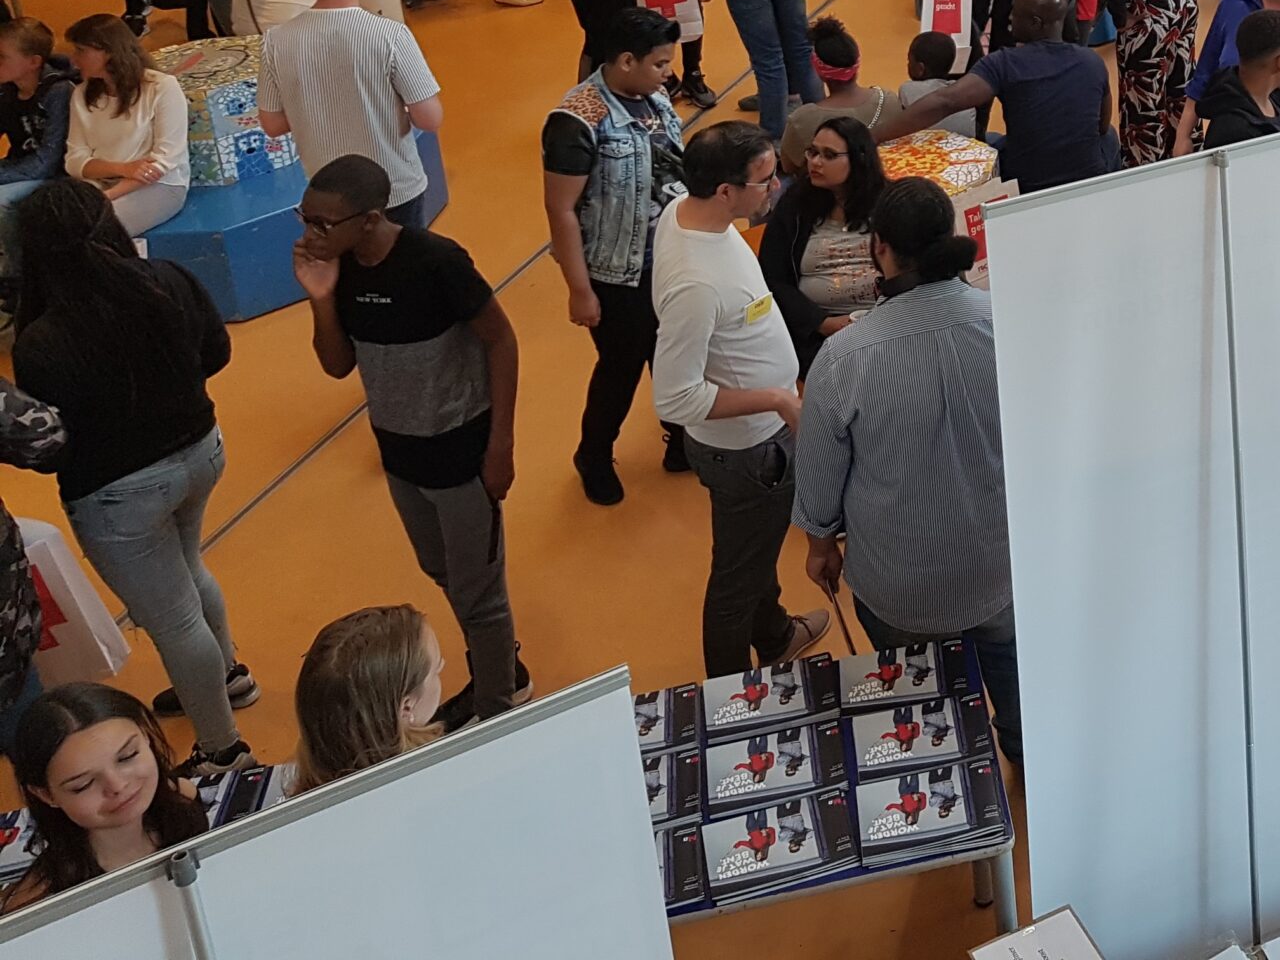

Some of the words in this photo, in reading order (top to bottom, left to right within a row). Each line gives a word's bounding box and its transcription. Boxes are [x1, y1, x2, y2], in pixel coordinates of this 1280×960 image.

[715, 710, 761, 726] WORDEN
[866, 752, 913, 767] WORDEN
[717, 782, 766, 799] WORDEN
[870, 825, 920, 840] WORDEN
[718, 860, 769, 880] WORDEN
